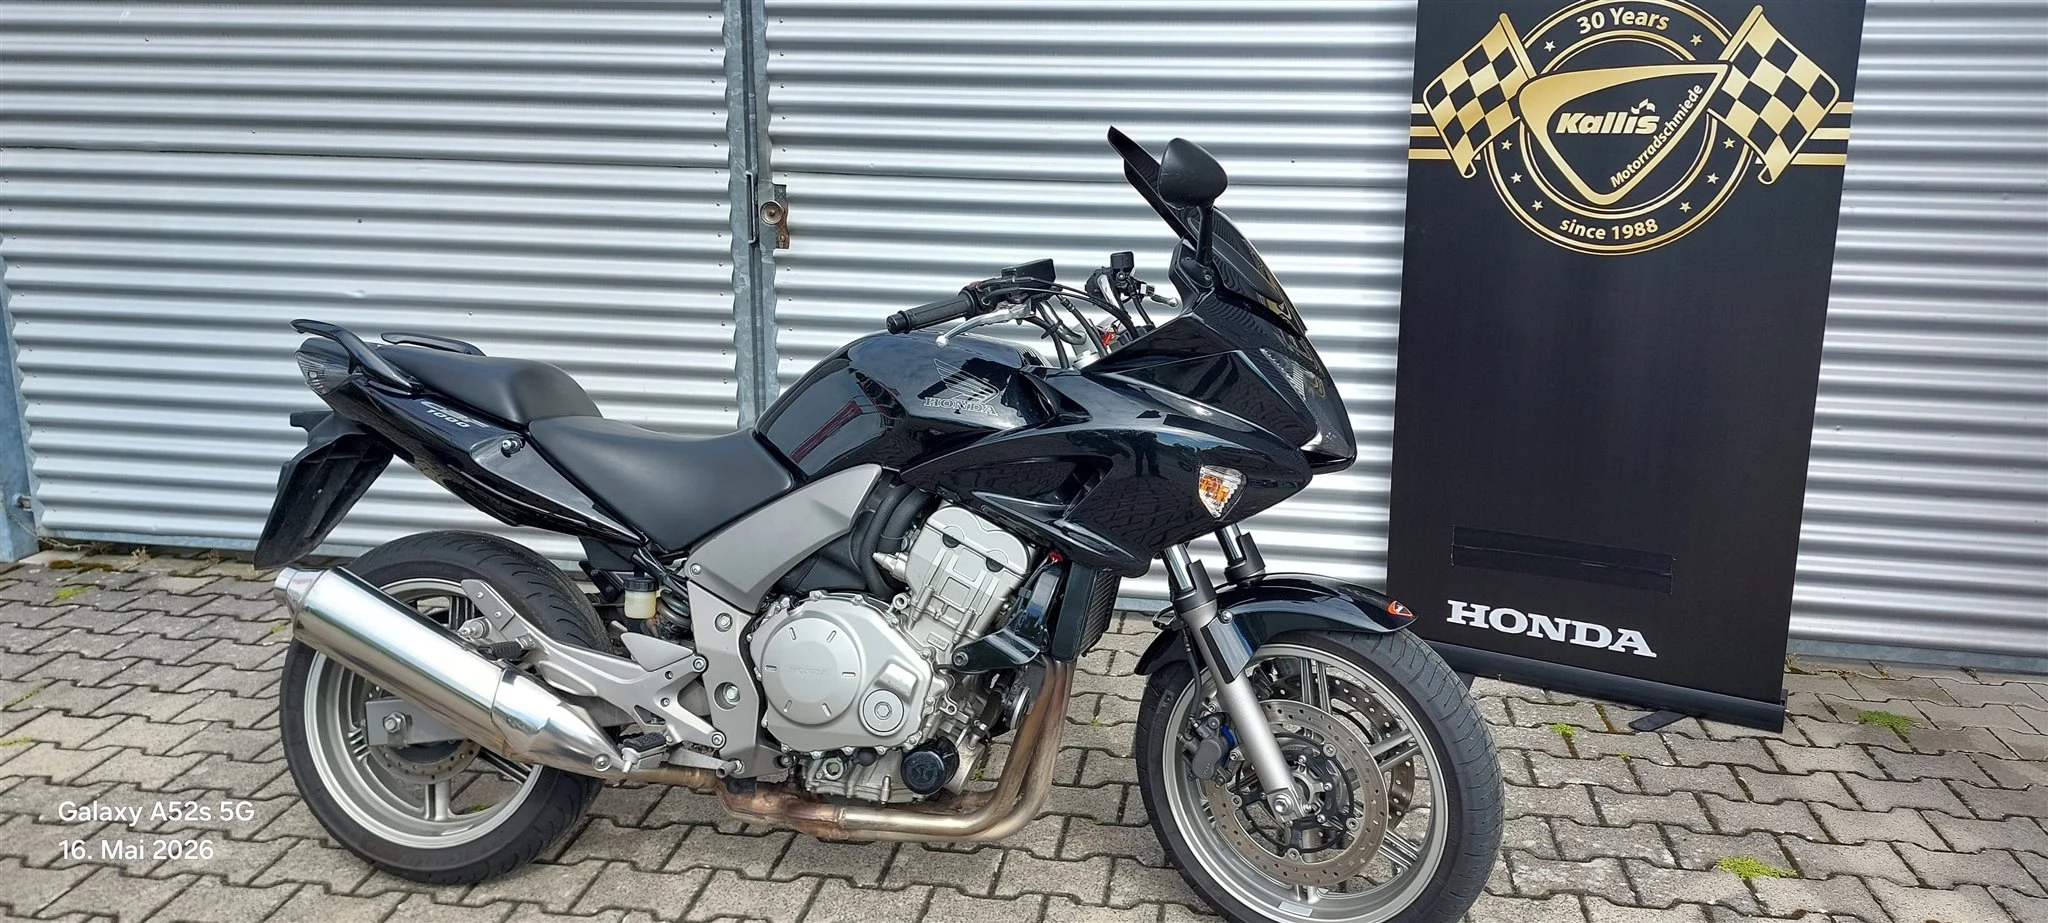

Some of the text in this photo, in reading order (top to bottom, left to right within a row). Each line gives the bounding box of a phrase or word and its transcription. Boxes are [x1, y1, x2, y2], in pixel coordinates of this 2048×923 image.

[1576, 6, 1670, 35] 30 Years
[1555, 111, 1660, 135] Kallis
[1609, 84, 1703, 188] Motorradschmiede
[1559, 218, 1659, 240] since 1988
[923, 396, 998, 416] HONDA
[427, 409, 470, 428] 1000
[1446, 599, 1657, 658] HONDA
